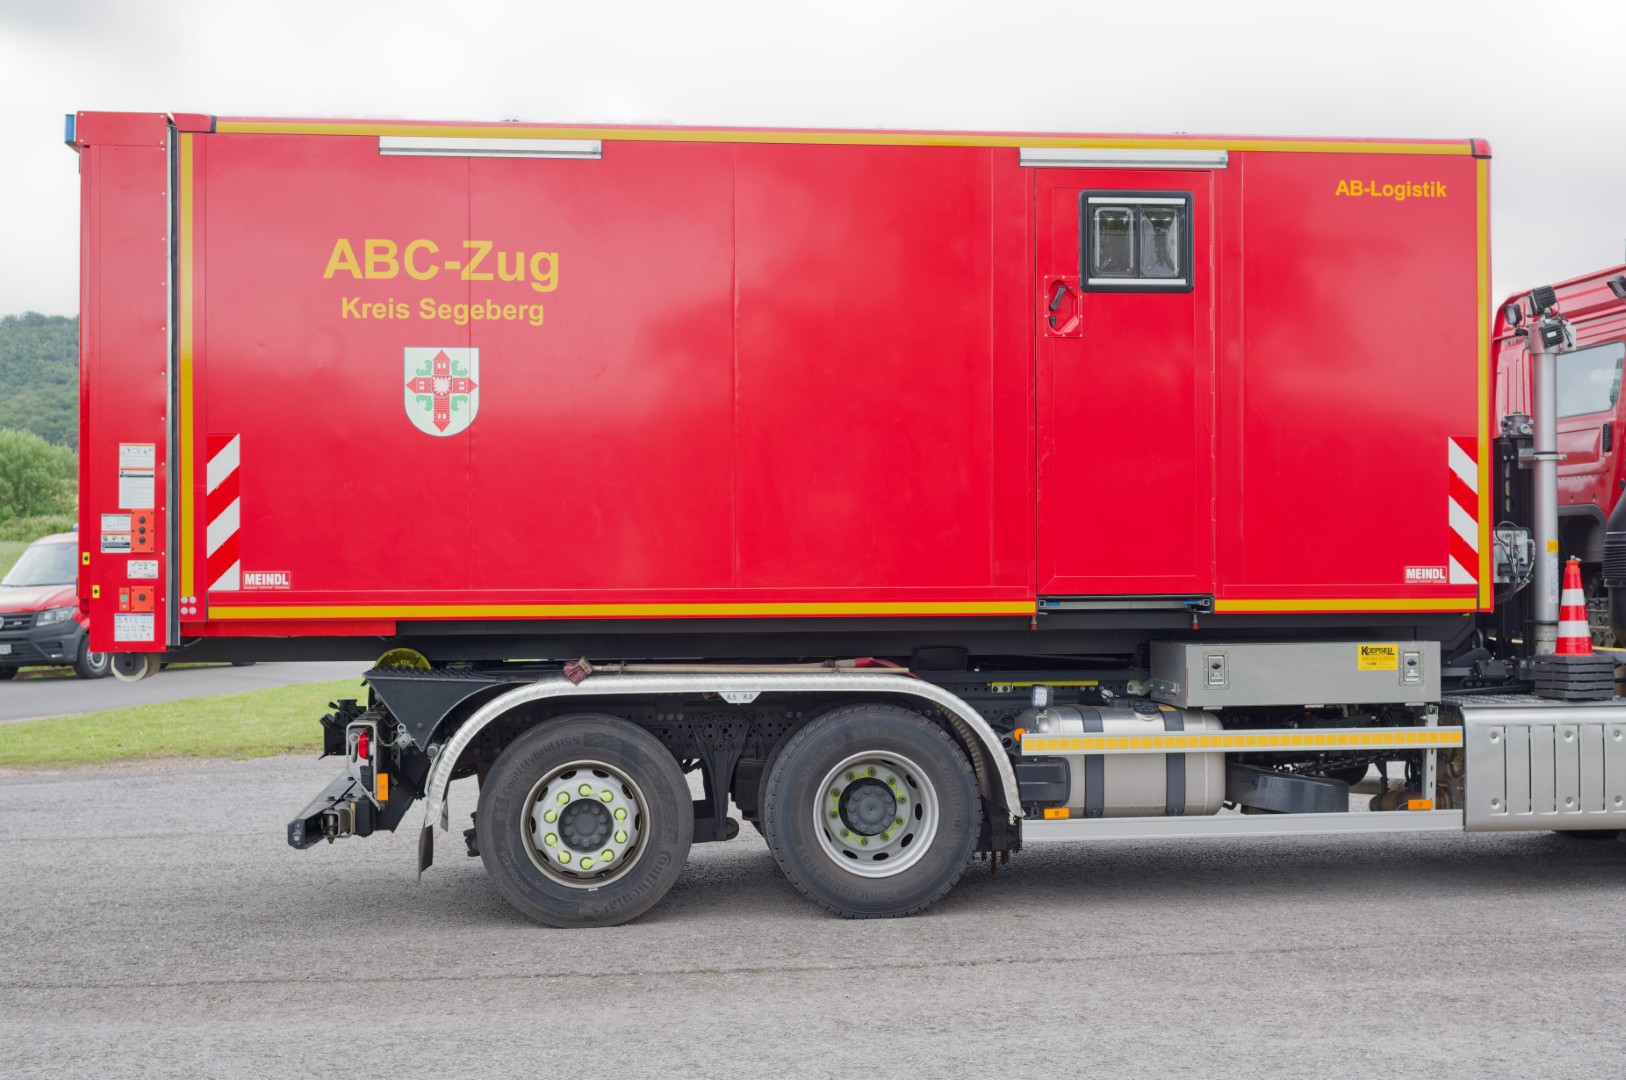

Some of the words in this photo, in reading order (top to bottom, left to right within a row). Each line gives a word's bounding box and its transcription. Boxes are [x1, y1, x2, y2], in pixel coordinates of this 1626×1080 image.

[1335, 179, 1447, 201] AB-Logistik
[323, 238, 559, 292] ABC-Zug
[341, 297, 410, 319] Kreis
[419, 298, 544, 326] Segeberg
[244, 573, 289, 586] MEINDL
[1406, 568, 1446, 579] MEINDL
[604, 850, 672, 914] Continental
